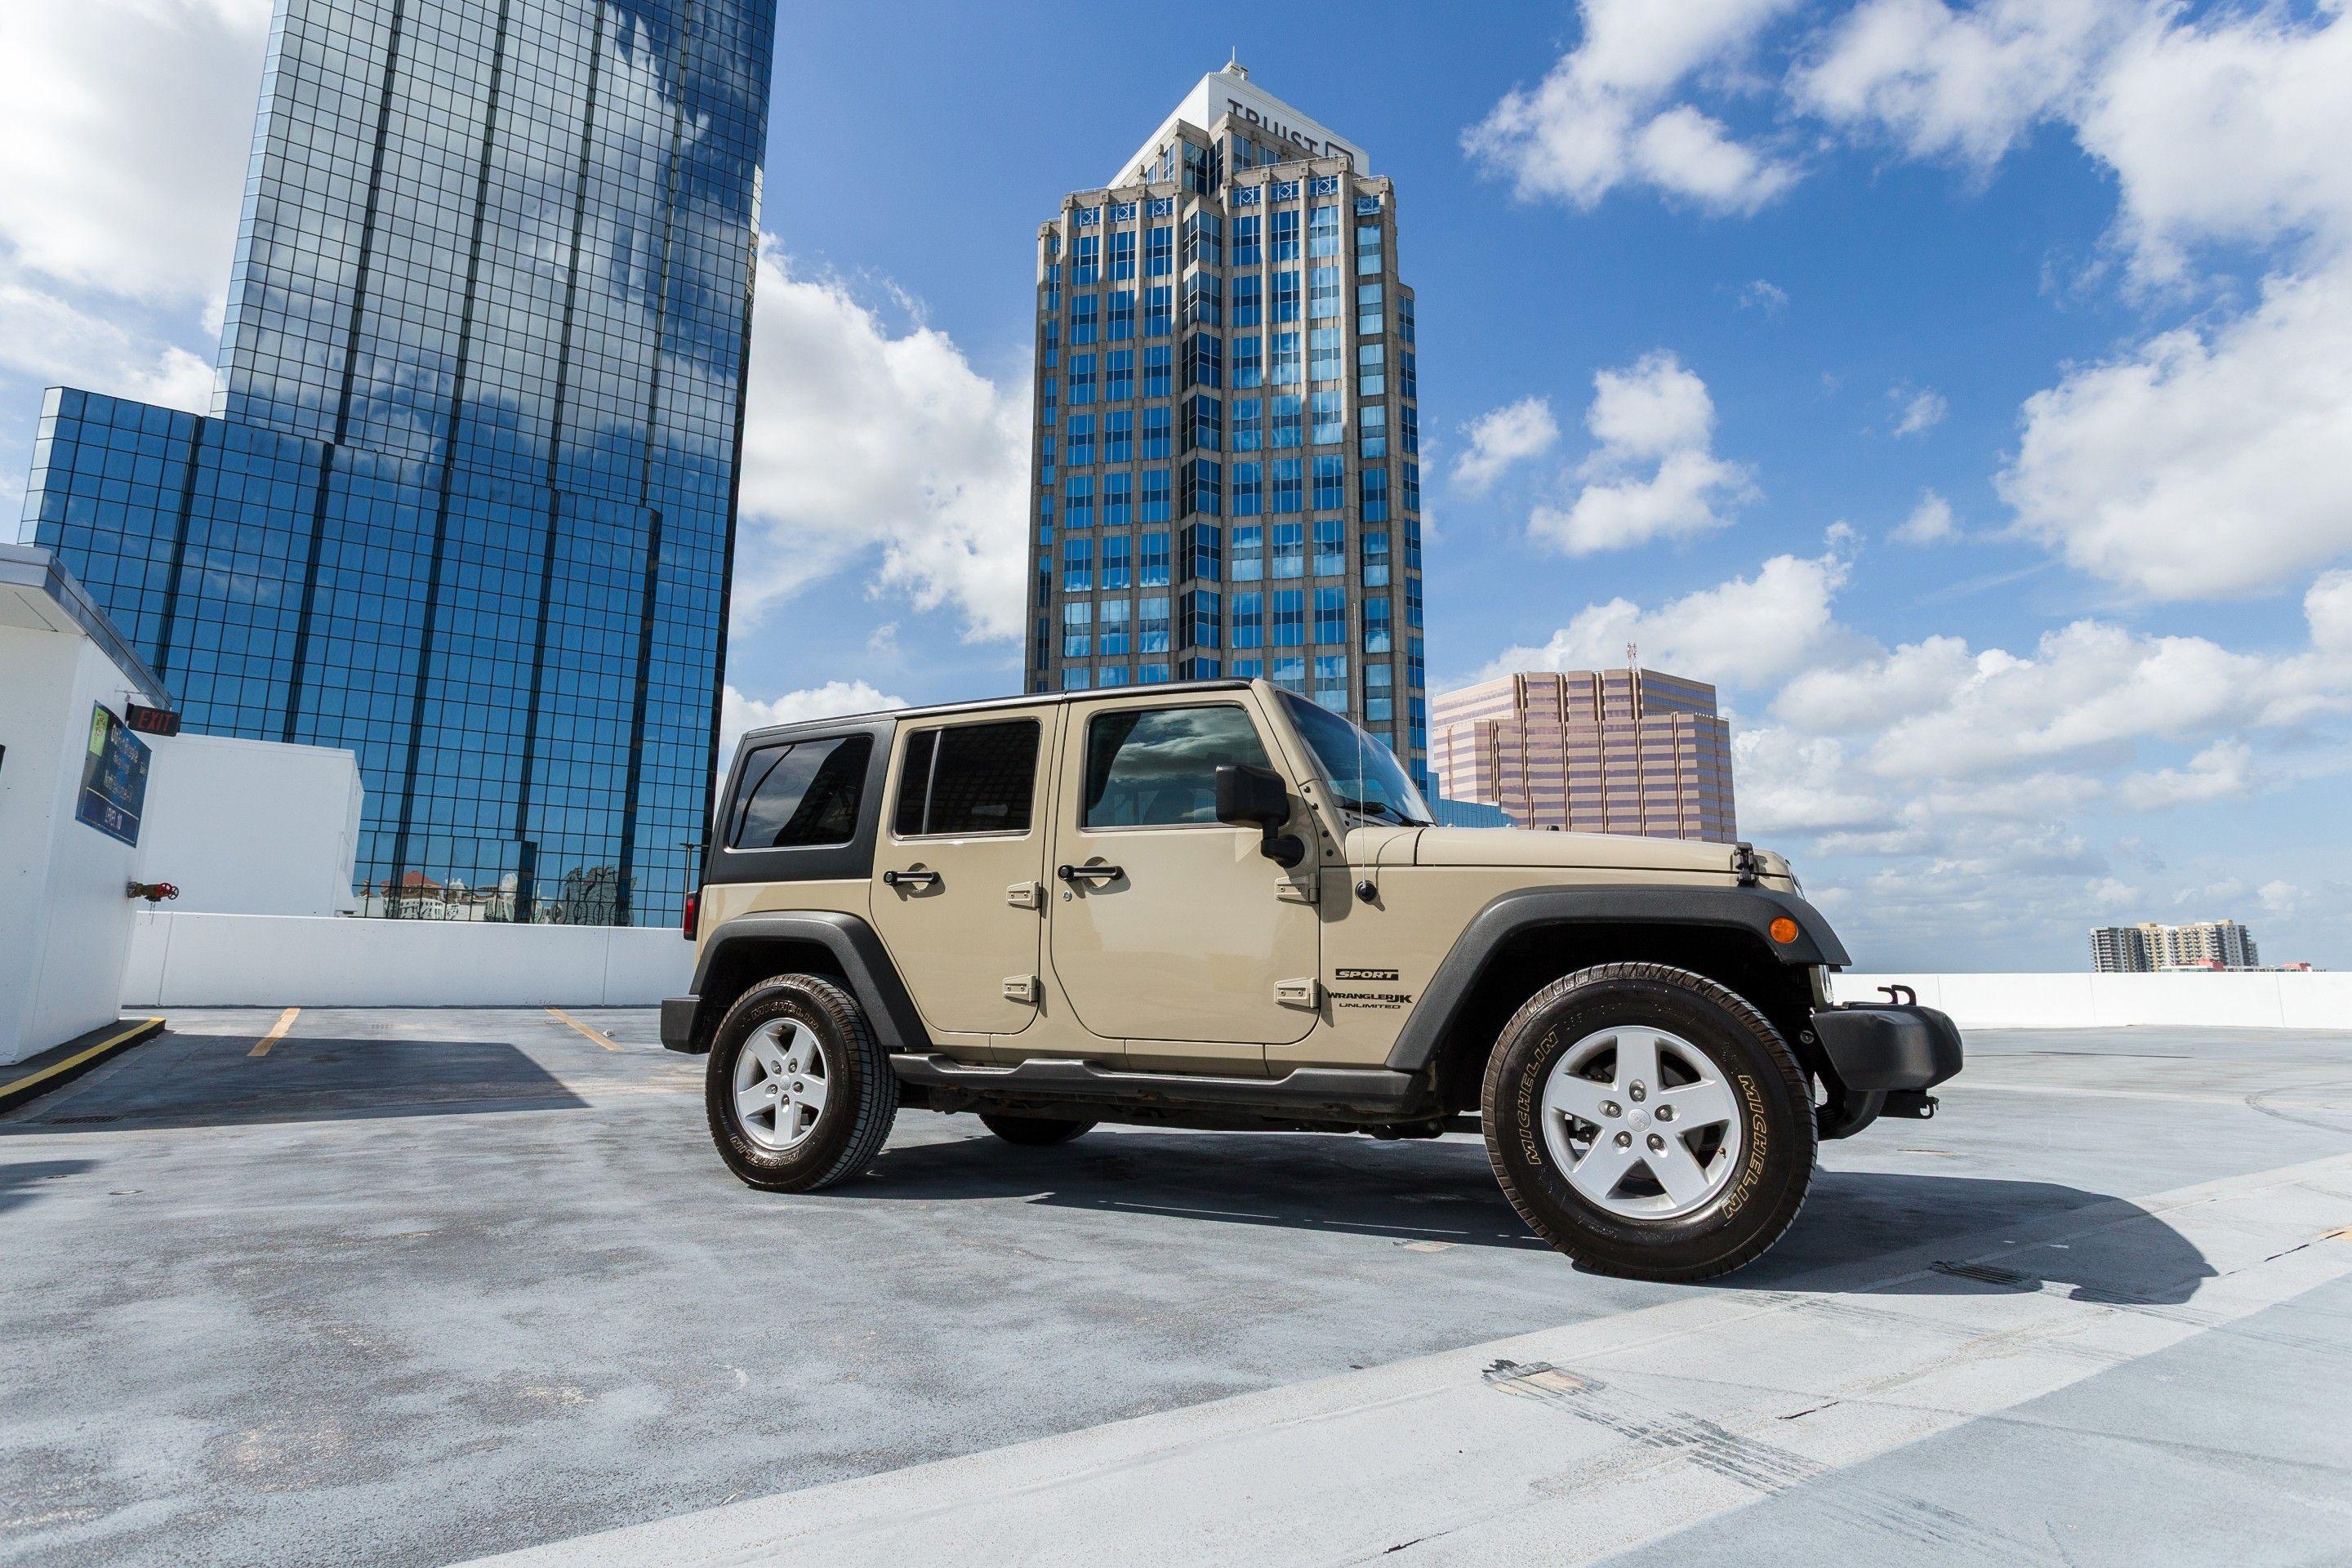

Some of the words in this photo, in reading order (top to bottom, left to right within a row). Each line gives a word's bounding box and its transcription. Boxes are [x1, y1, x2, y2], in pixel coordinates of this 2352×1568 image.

[137, 709, 173, 733] EXIT
[1339, 969, 1398, 979] SPORT
[751, 1000, 819, 1030] MICHELIN
[1518, 1031, 1558, 1165] MICHELIN
[729, 1136, 800, 1166] MICHELIN
[1722, 1075, 1766, 1219] MICHELIN
